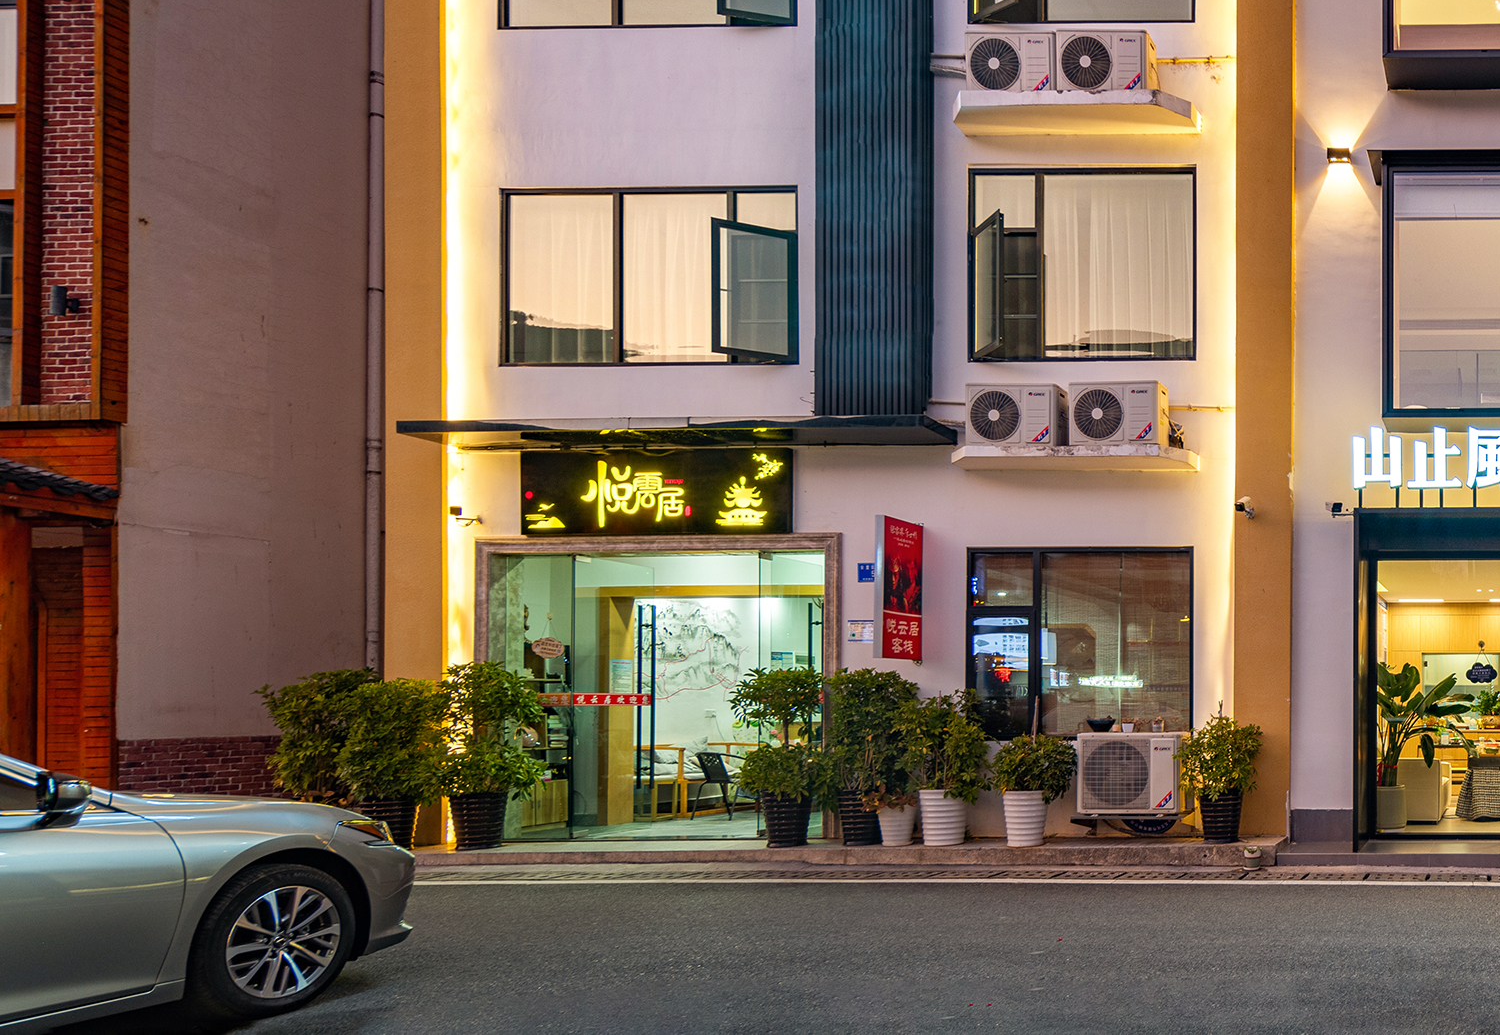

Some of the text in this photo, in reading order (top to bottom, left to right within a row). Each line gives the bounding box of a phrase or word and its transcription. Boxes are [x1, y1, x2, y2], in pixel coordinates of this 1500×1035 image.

[886, 618, 920, 637] 悦云居
[891, 637, 914, 655] 客栈
